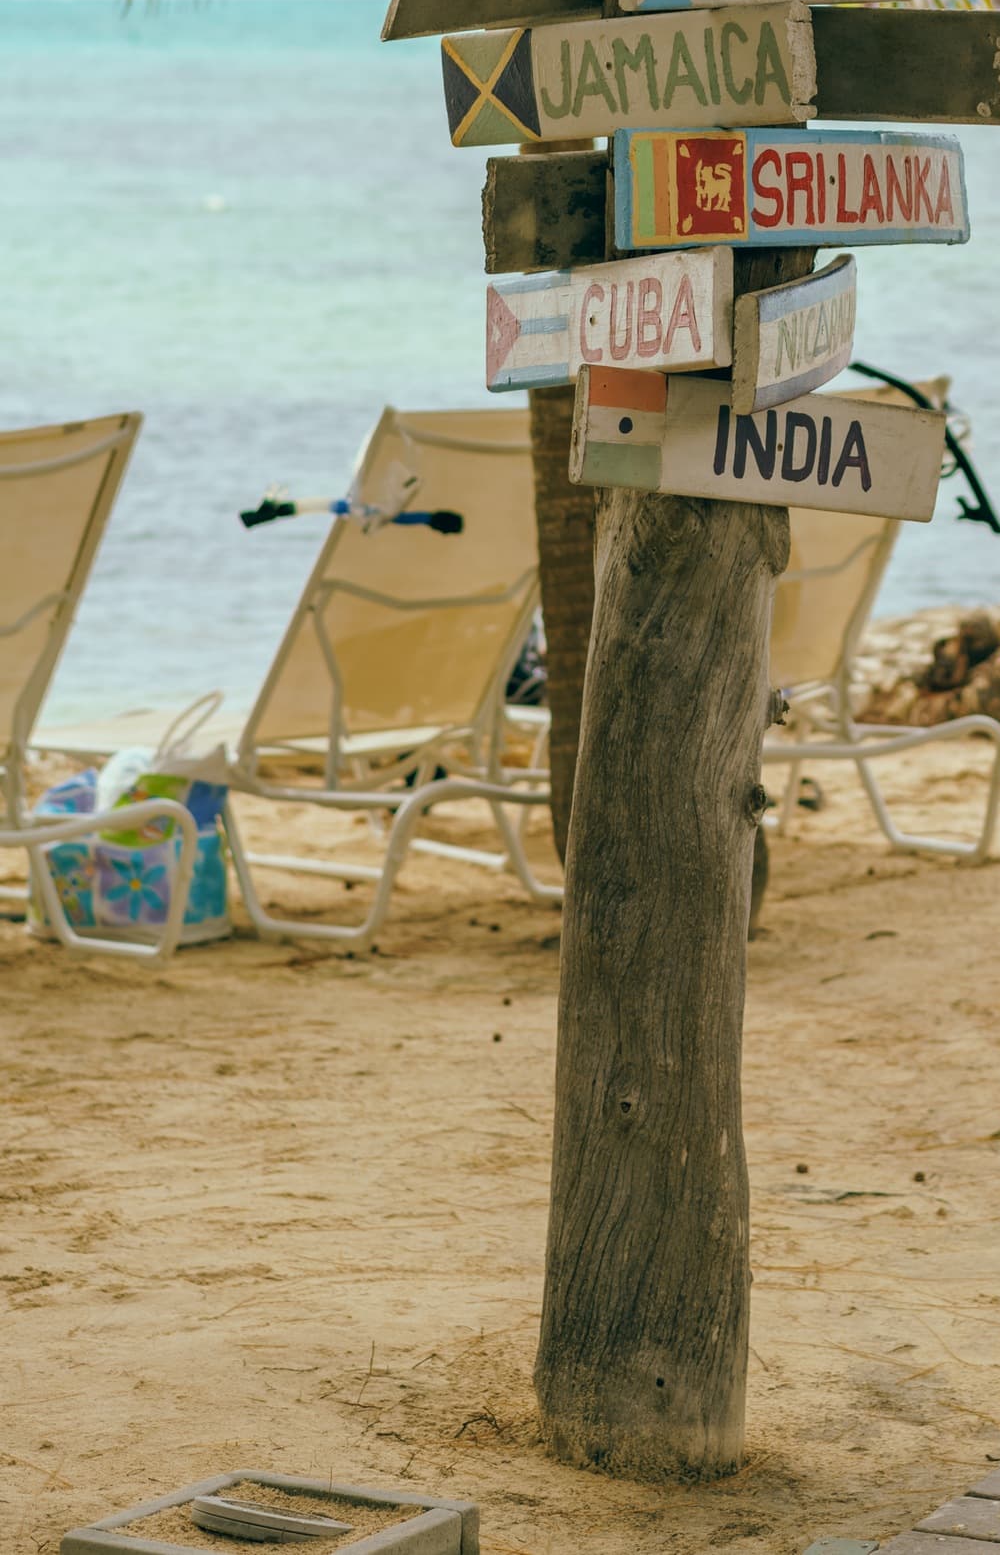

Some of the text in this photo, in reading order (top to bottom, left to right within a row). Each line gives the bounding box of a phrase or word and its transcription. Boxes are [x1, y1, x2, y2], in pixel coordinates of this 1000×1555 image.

[540, 21, 792, 120] JAMAICA
[751, 149, 954, 227] SRI LANKA
[579, 273, 701, 362] CUBA
[713, 404, 872, 493] INDIA
